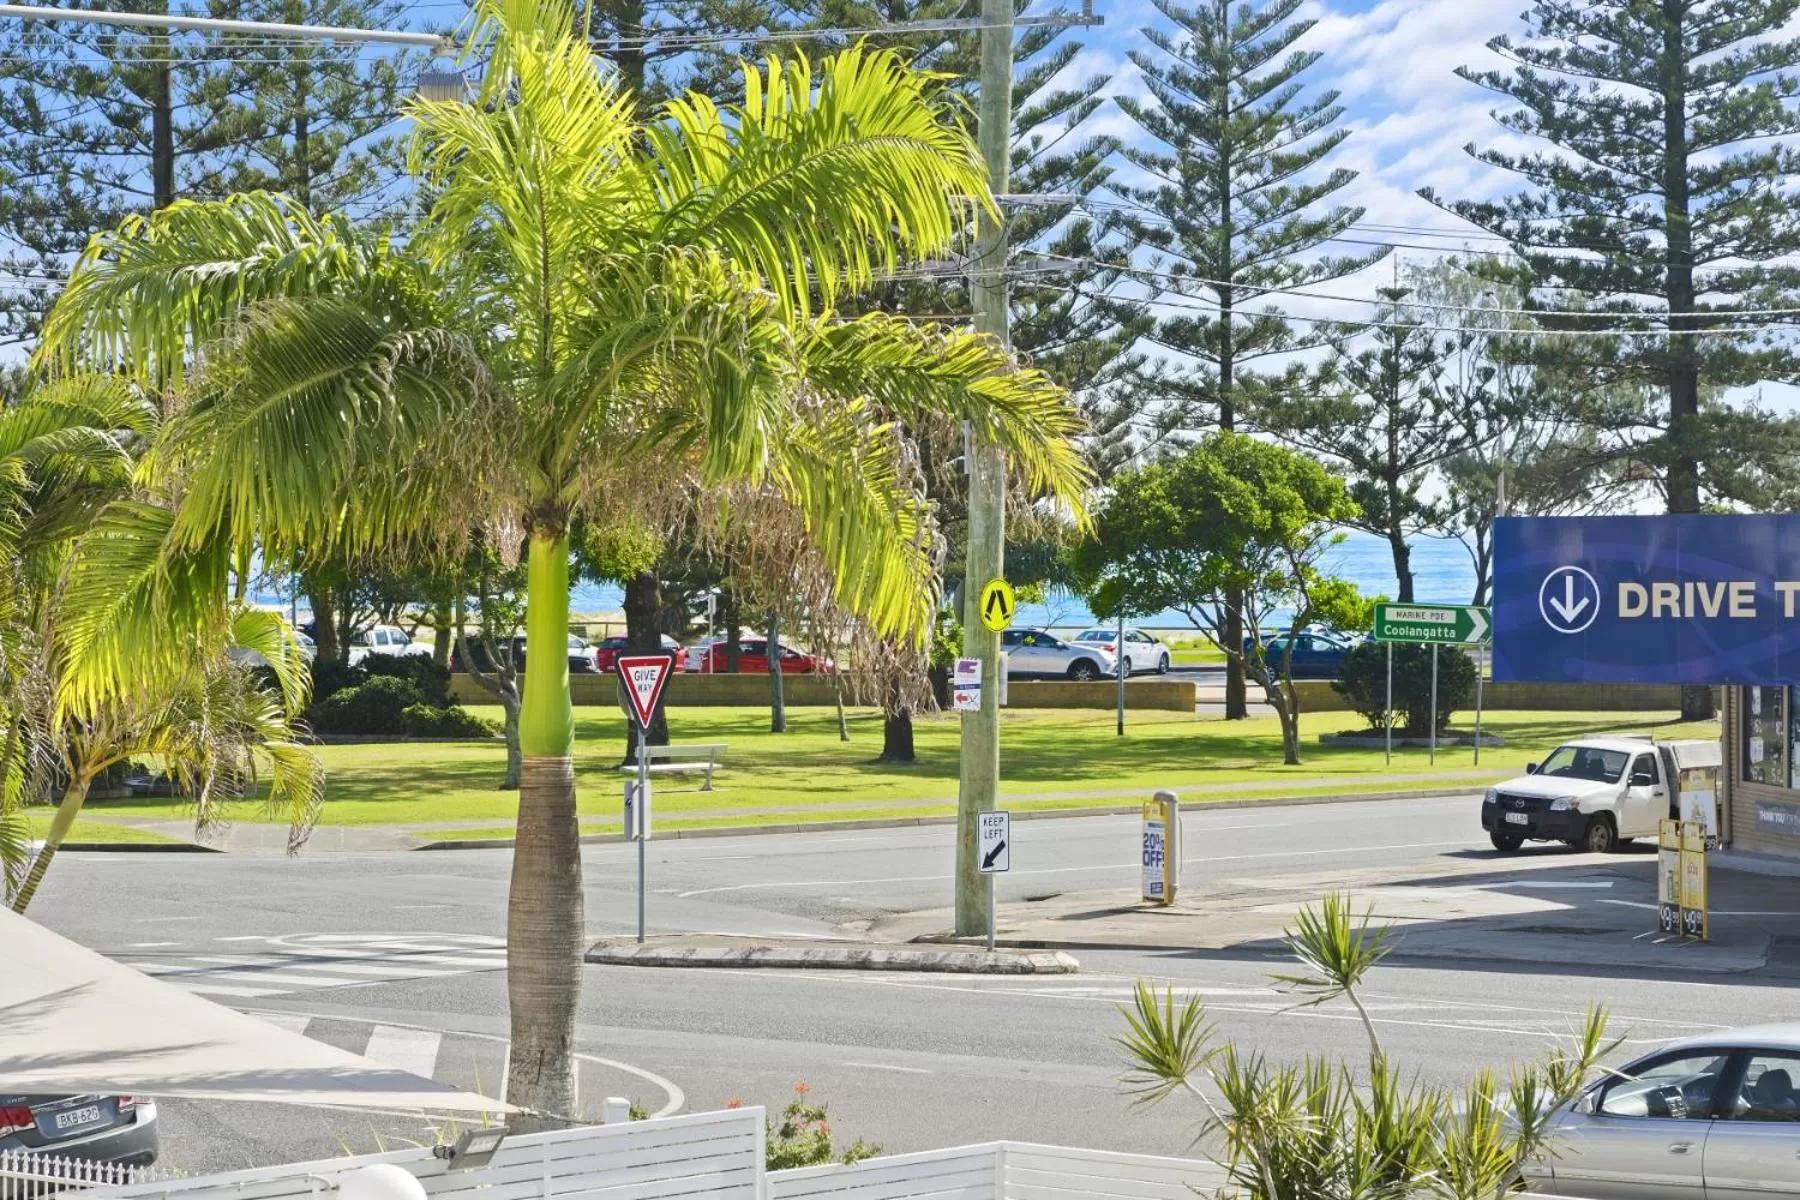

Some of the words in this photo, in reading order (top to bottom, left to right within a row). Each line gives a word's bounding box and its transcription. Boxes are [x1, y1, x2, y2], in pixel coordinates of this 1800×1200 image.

[1618, 581, 1757, 618] DRIVE
[1396, 611, 1426, 620] MARINE
[1430, 612, 1445, 621] PDE
[1384, 624, 1457, 640] Coolangatta
[634, 669, 656, 681] GIVE
[638, 684, 653, 692] WAY
[983, 816, 1004, 827] KEEP
[984, 829, 1002, 840] LEFT
